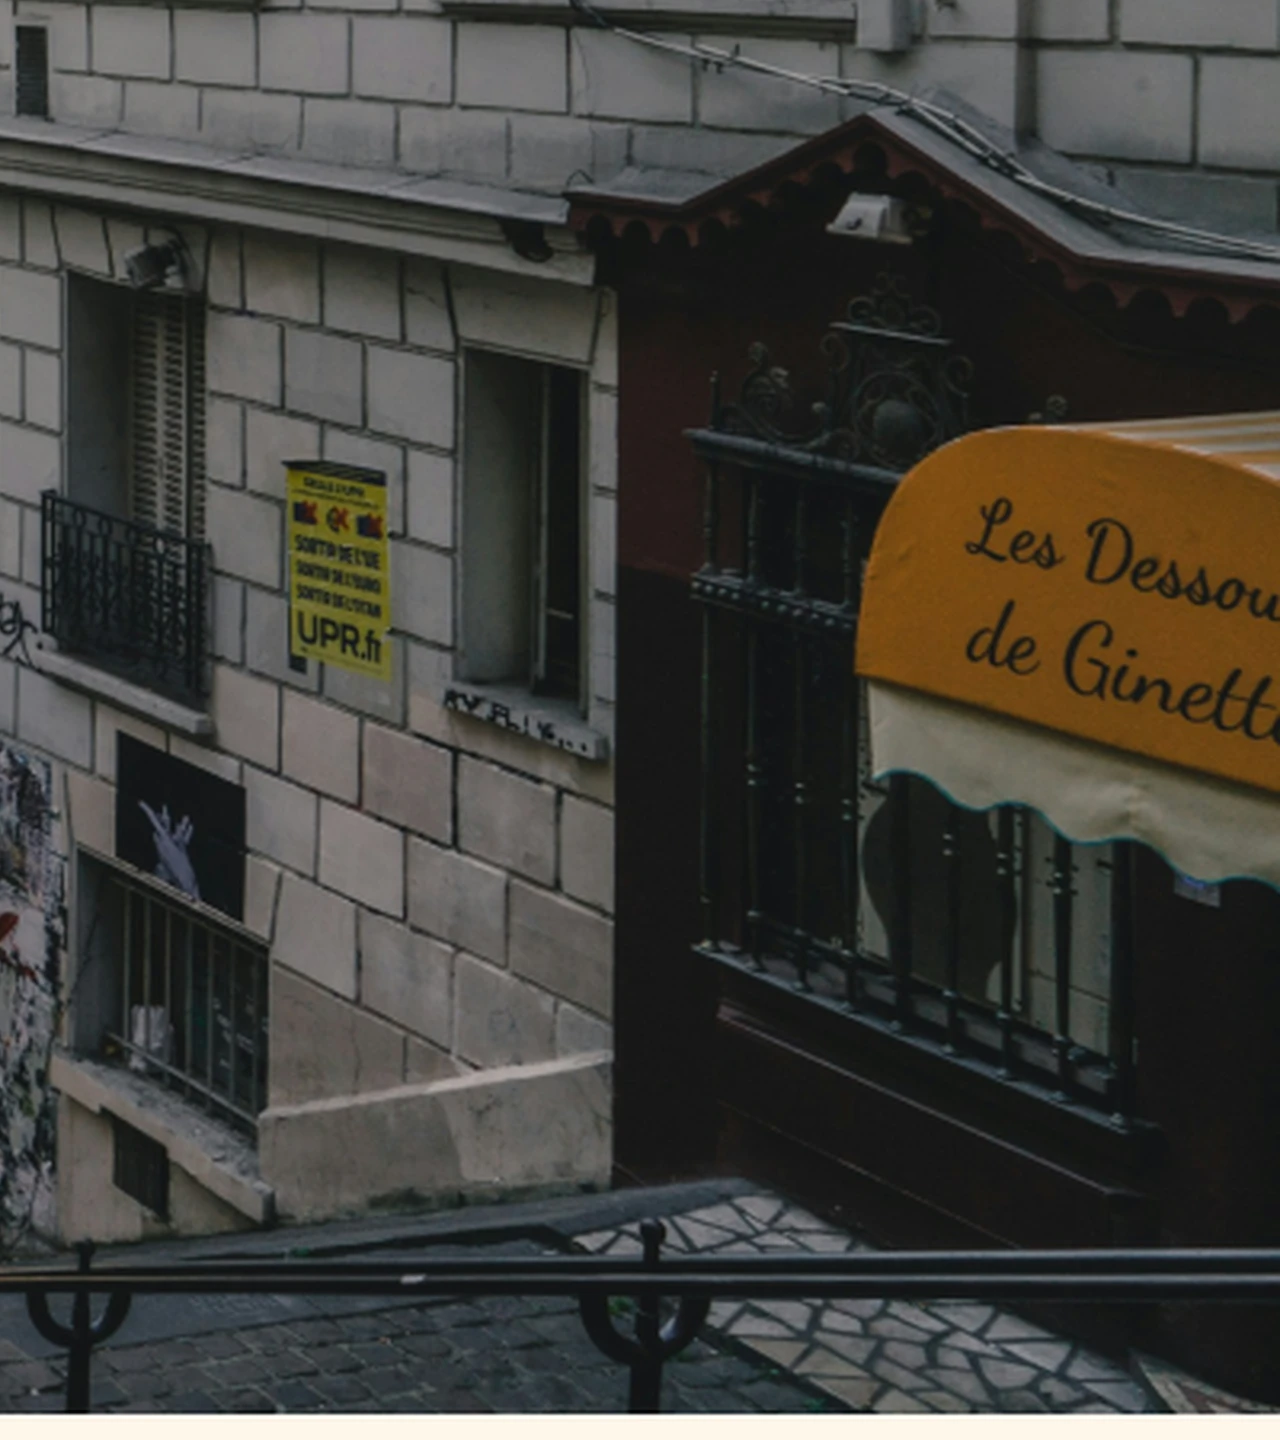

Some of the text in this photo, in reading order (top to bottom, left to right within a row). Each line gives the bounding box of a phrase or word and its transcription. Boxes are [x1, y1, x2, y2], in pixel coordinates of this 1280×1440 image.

[965, 497, 1065, 570] Les
[297, 611, 383, 665] UPR.fr
[965, 599, 1040, 675] de
